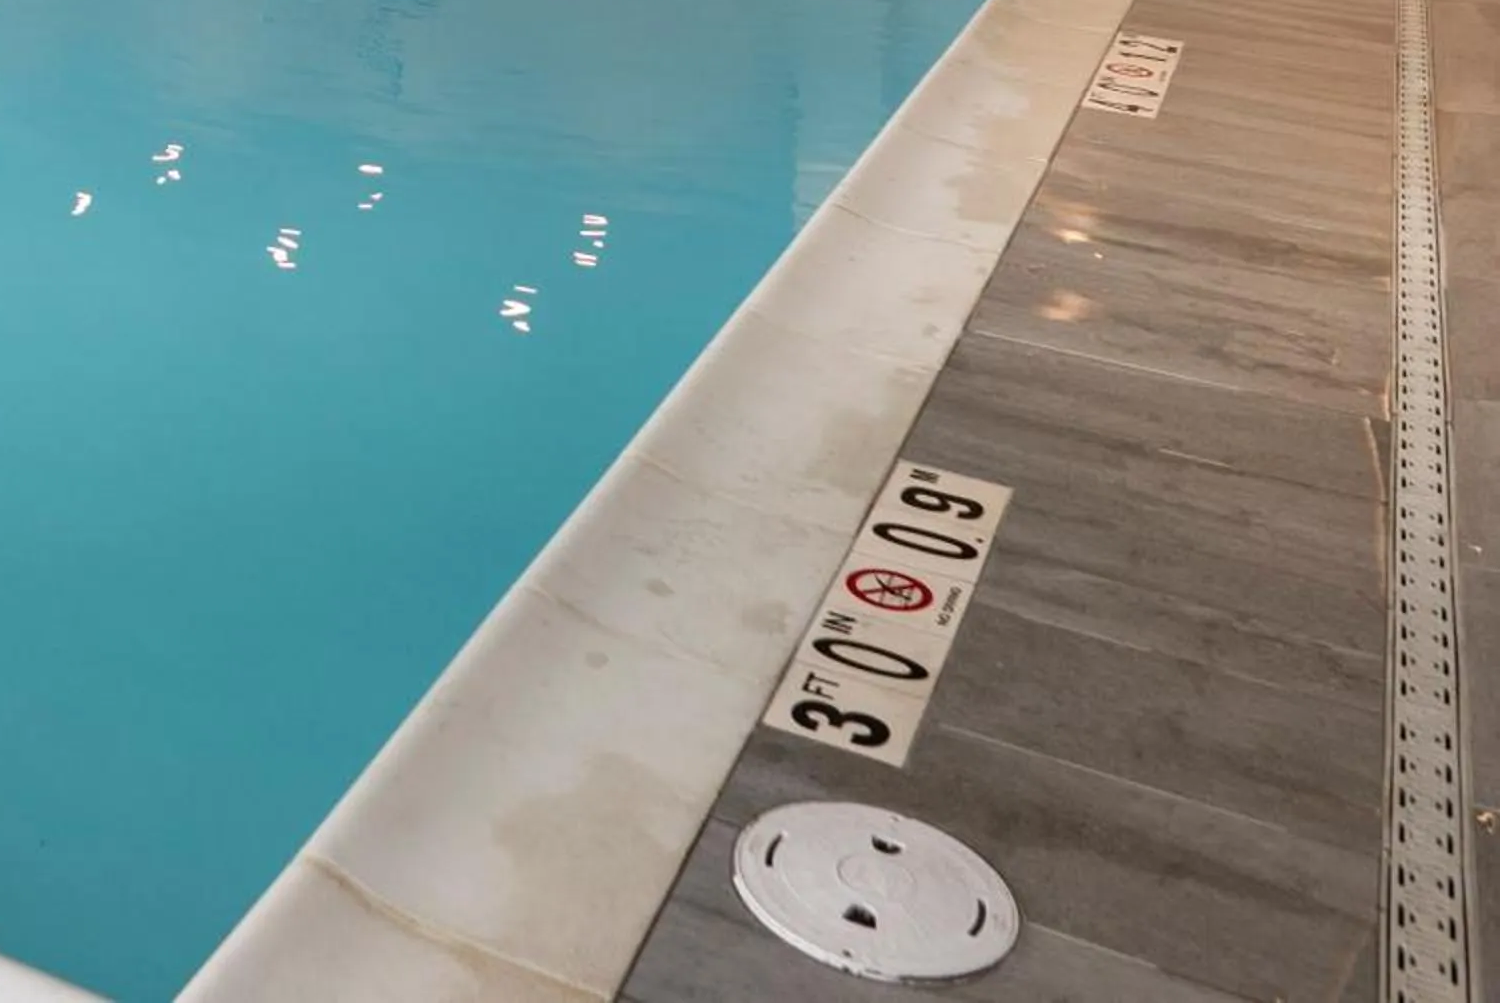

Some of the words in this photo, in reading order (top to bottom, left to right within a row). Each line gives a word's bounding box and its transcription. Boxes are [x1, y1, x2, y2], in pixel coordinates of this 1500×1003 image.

[822, 611, 856, 636] IN
[811, 638, 929, 681] 0
[803, 672, 840, 701] FT
[791, 699, 891, 748] 3
